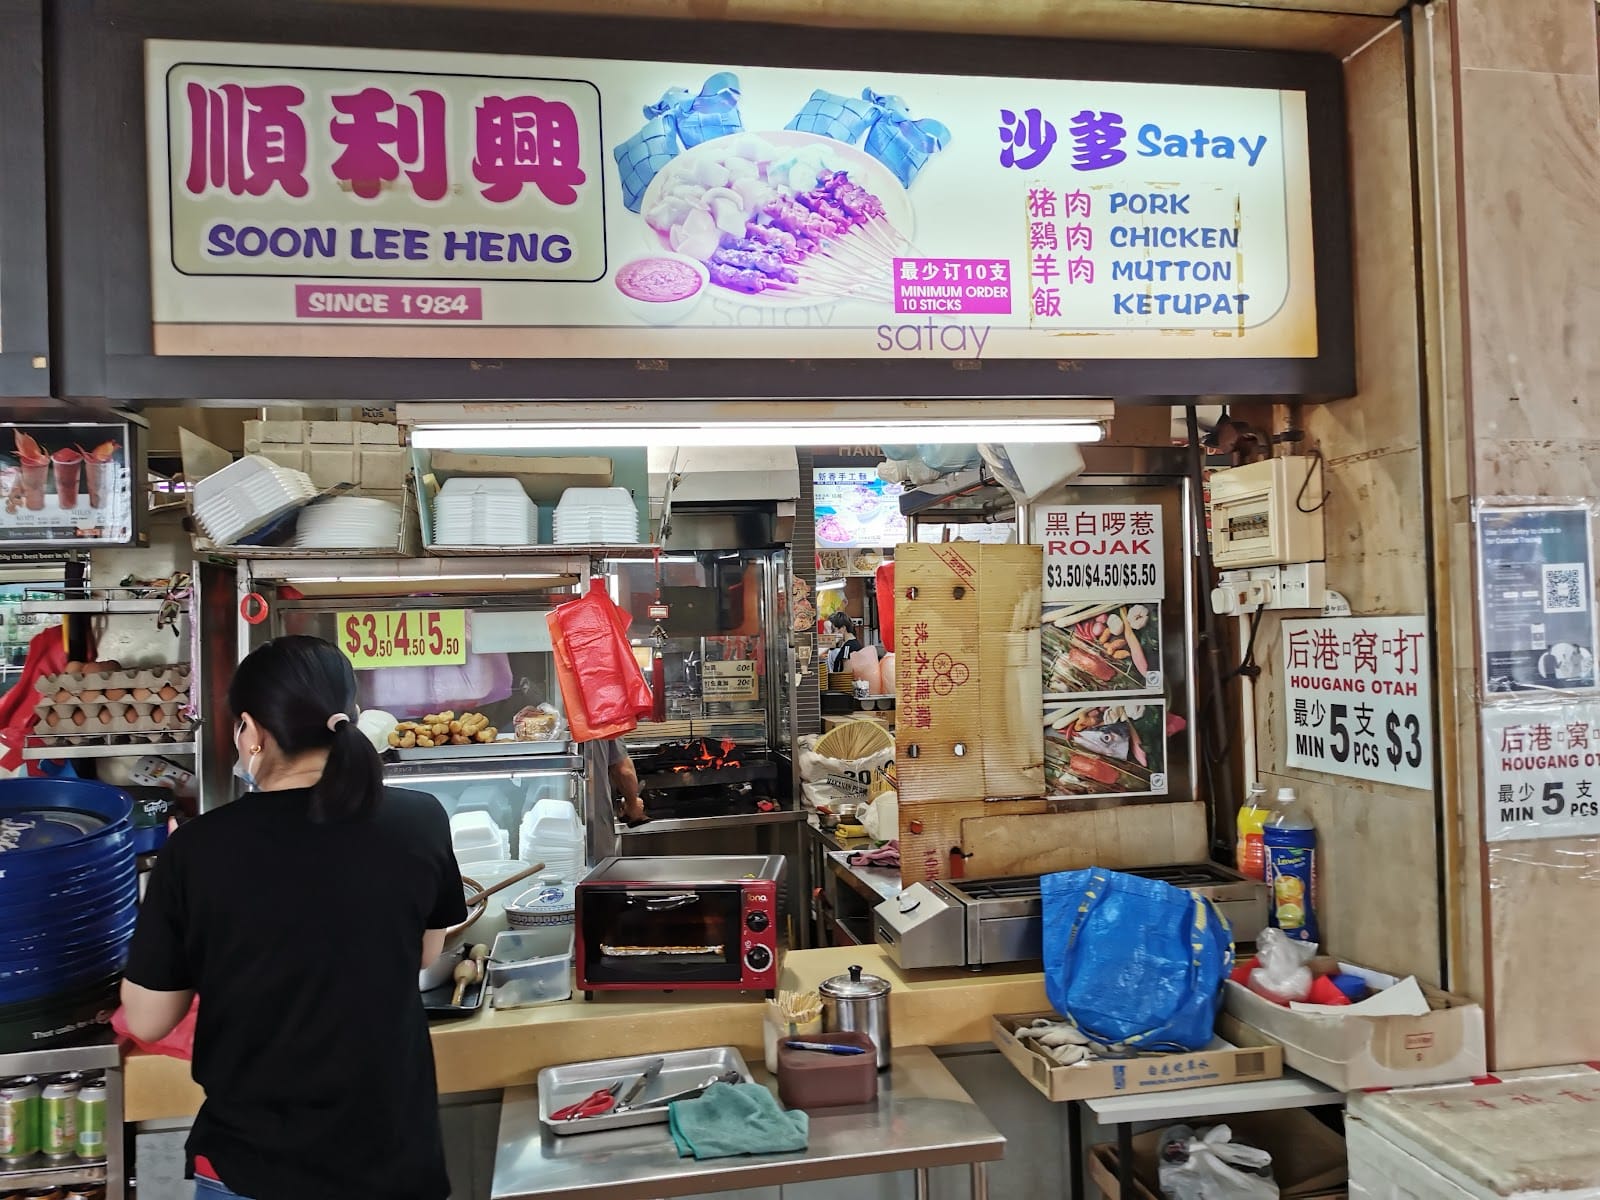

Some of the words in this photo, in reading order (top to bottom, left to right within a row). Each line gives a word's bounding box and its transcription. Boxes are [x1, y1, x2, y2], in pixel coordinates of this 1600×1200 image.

[186, 82, 586, 205] 順利興
[1136, 123, 1267, 167] Satay
[1109, 192, 1191, 215] PORK
[207, 223, 337, 258] SOON
[350, 227, 431, 261] LEE
[443, 230, 573, 264] HENG
[1109, 226, 1240, 249] CHICKEN
[900, 261, 1008, 281] 最少订10支
[1031, 253, 1095, 285] 羊肉
[1111, 260, 1232, 282] MUTTON
[307, 291, 389, 314] SINCE
[401, 293, 469, 315] 1984
[900, 285, 963, 298] MINIMUM
[965, 286, 1008, 298] ORDER
[1031, 287, 1062, 317] 飯
[902, 299, 917, 310] 10
[920, 298, 962, 311] STICKS
[1113, 293, 1250, 316] KETUPAT
[876, 316, 991, 359] satay
[1048, 539, 1152, 556] ROJAK
[1290, 675, 1366, 693] HOUGANG
[1371, 679, 1418, 697] OTAH
[1293, 698, 1327, 729] 最少
[1329, 703, 1350, 764] 5
[1353, 701, 1376, 738] 支
[1386, 708, 1423, 772] $3
[1295, 733, 1325, 759] MIN
[1353, 740, 1380, 768] PCS
[1502, 753, 1580, 772] HOUGANG
[1497, 781, 1535, 804] 最少
[1541, 781, 1566, 816] 5
[1575, 779, 1593, 799] 支
[1500, 806, 1534, 822] MIN
[1570, 801, 1599, 817] PCS
